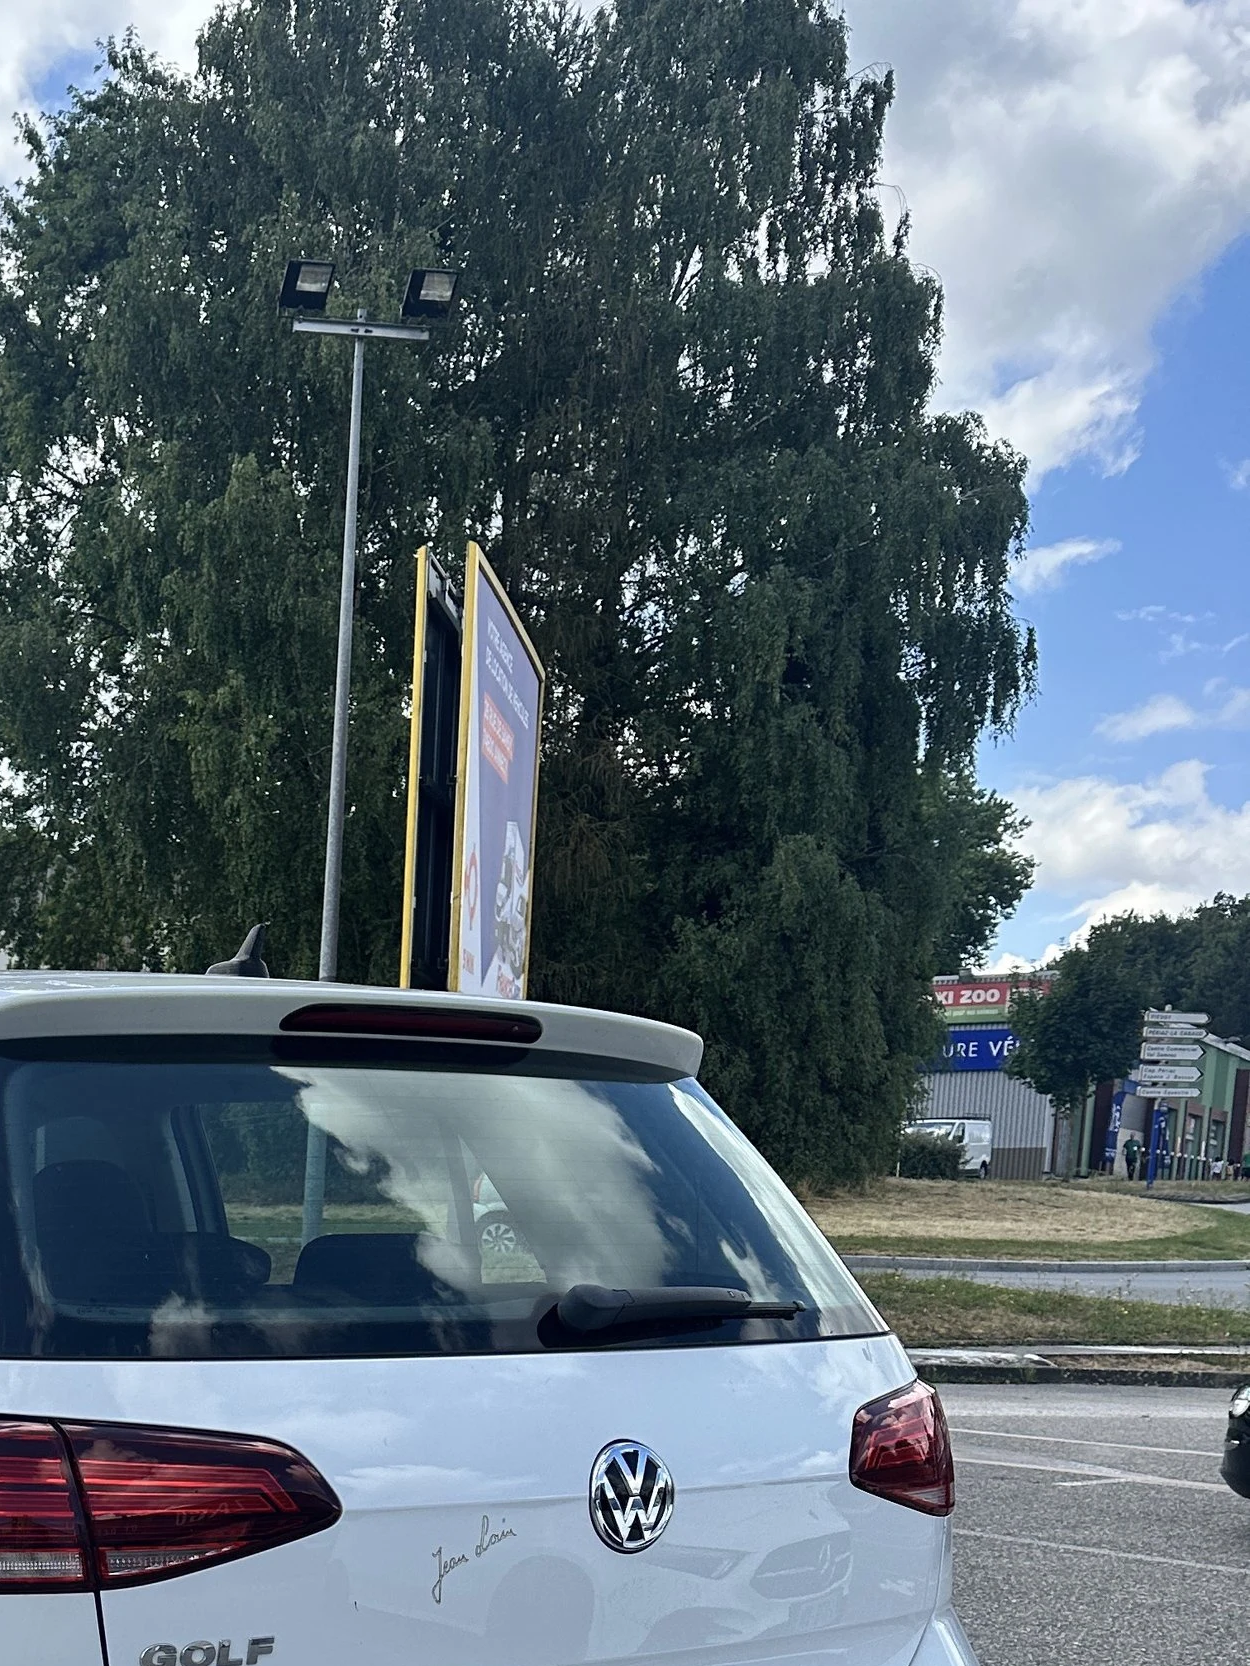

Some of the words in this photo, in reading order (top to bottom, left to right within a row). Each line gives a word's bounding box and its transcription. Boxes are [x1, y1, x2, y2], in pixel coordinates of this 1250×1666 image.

[934, 991, 954, 1005] XI
[960, 989, 1001, 1003] ZOO
[943, 1042, 978, 1058] URE
[989, 1035, 1020, 1058] VÉ
